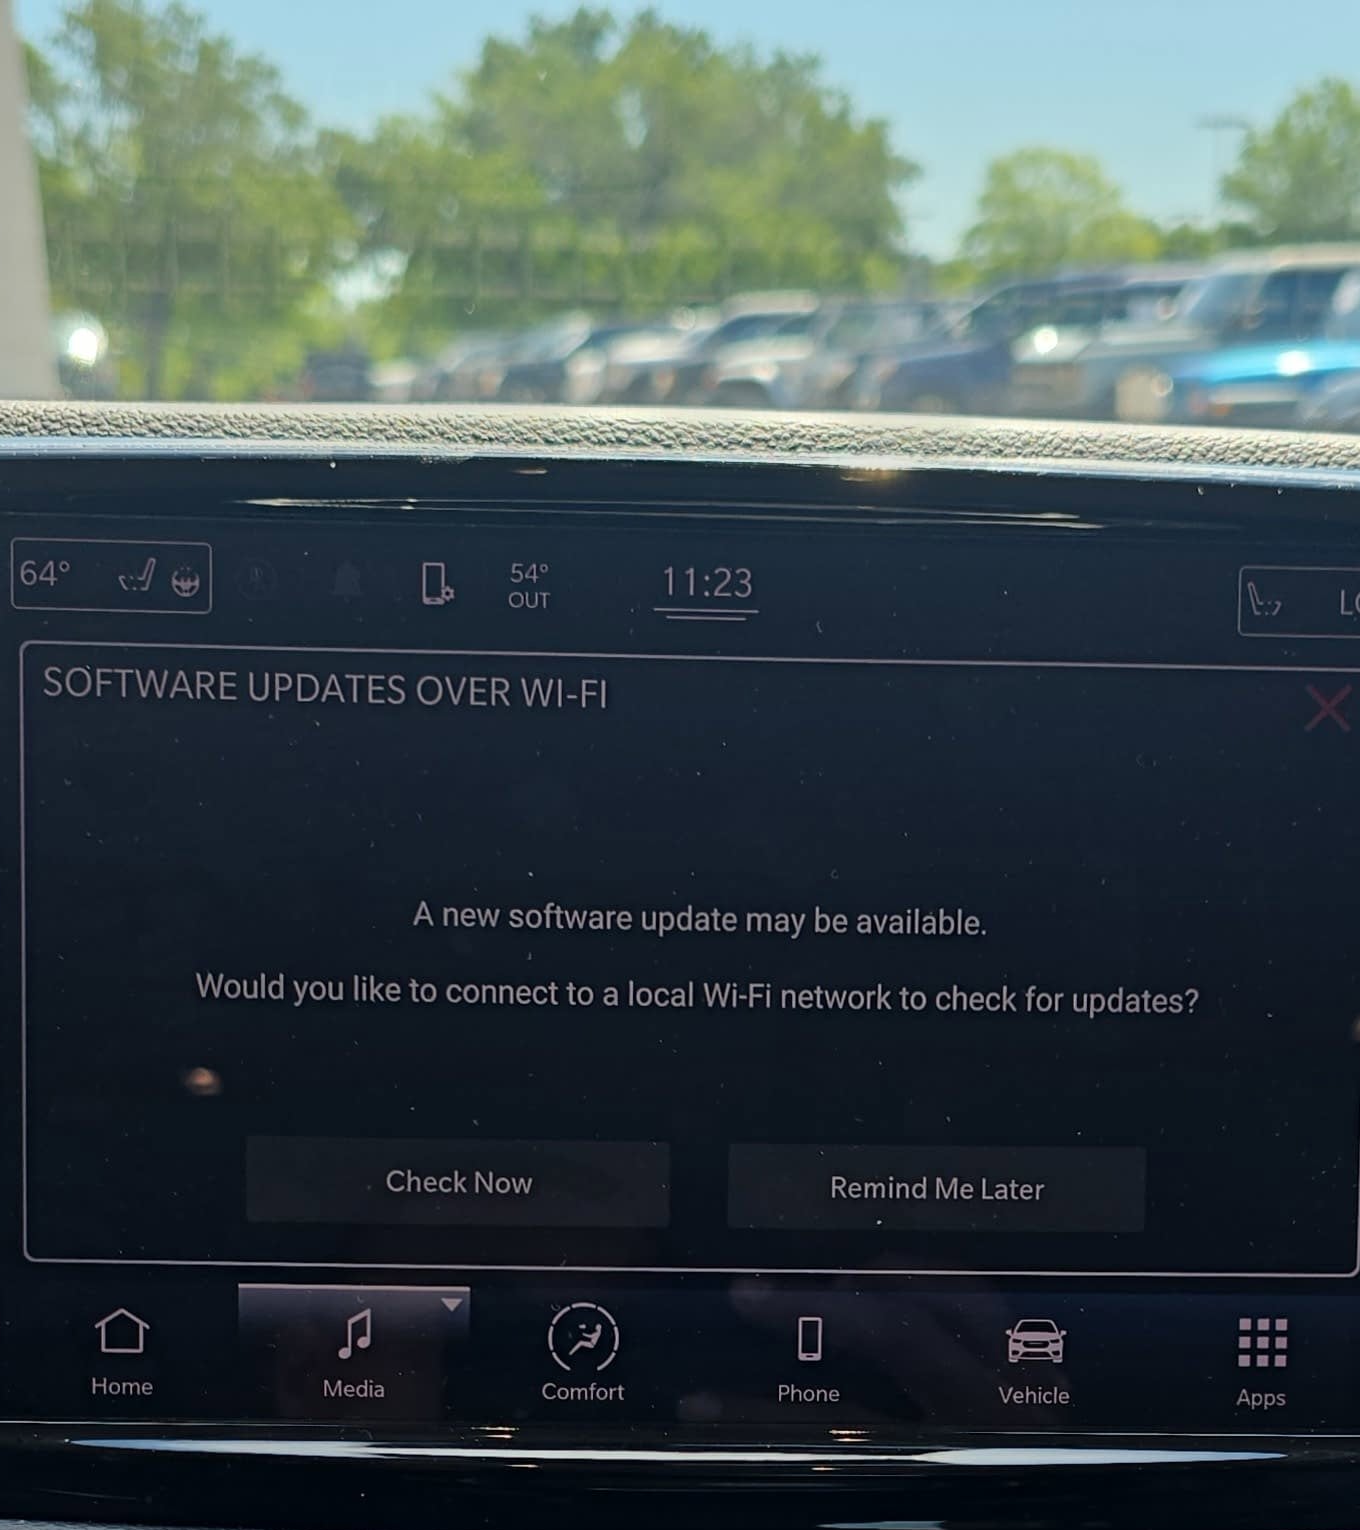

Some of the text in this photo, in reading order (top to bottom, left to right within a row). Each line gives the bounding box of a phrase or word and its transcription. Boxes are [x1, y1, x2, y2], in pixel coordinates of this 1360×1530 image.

[20, 559, 70, 587] 64°
[510, 562, 549, 584] 54°
[664, 566, 752, 598] 11:23
[508, 591, 551, 609] OUT
[43, 664, 606, 709] SOFTWARE UPDATES OVER WI-FI
[413, 900, 987, 940] A new software update may be available.
[195, 972, 1199, 1019] Would you like to connect to a local Wi-Fi network to check for updates?
[386, 1169, 533, 1194] Check Now
[831, 1175, 1045, 1201] Remind Me Later
[92, 1377, 154, 1396] Home
[323, 1379, 385, 1398] Media
[541, 1382, 625, 1401] Comfort
[778, 1383, 840, 1402] Phone
[998, 1385, 1070, 1404] Vehicle
[1236, 1388, 1286, 1410] Apps
